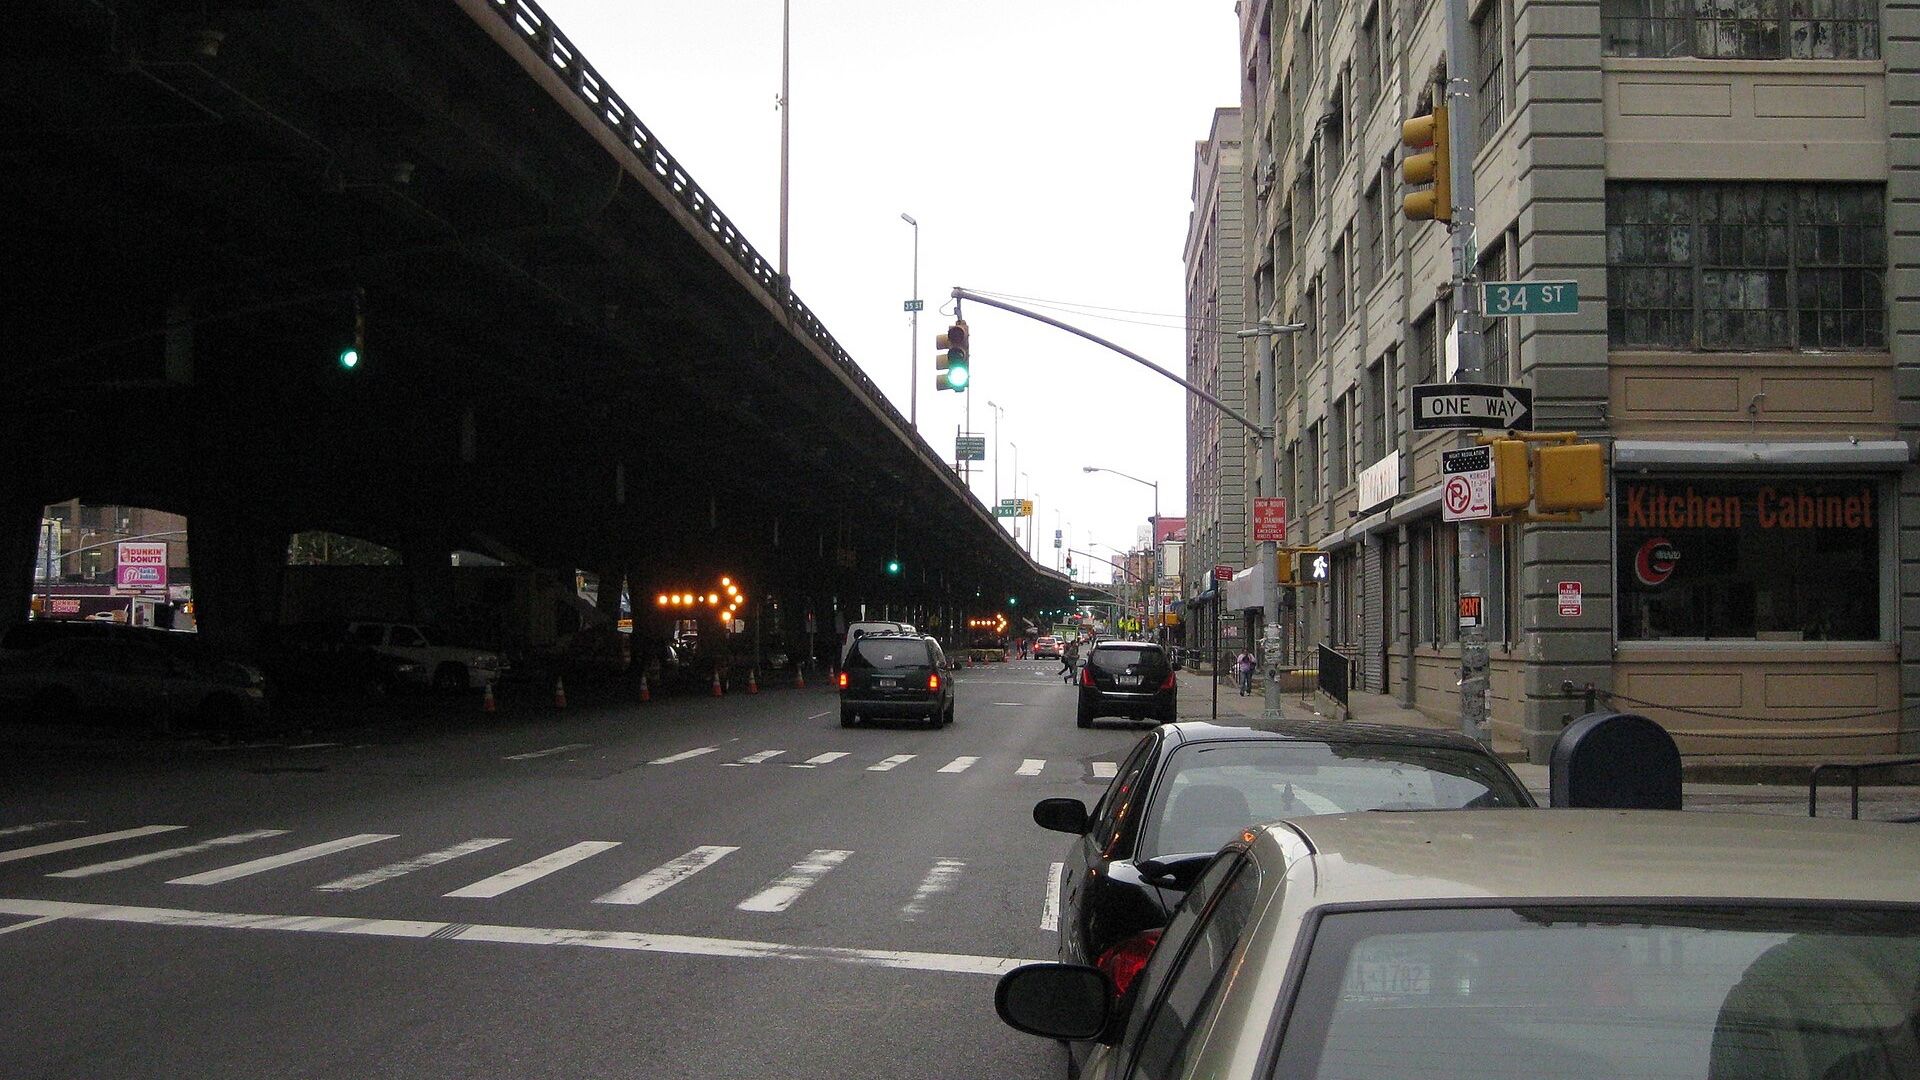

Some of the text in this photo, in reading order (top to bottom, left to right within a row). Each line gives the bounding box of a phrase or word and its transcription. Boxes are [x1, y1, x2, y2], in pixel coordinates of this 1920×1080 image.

[1497, 285, 1564, 312] 34 ST
[1432, 397, 1517, 417] ONE WAY
[1626, 485, 1873, 529] Kitchen Cabinet
